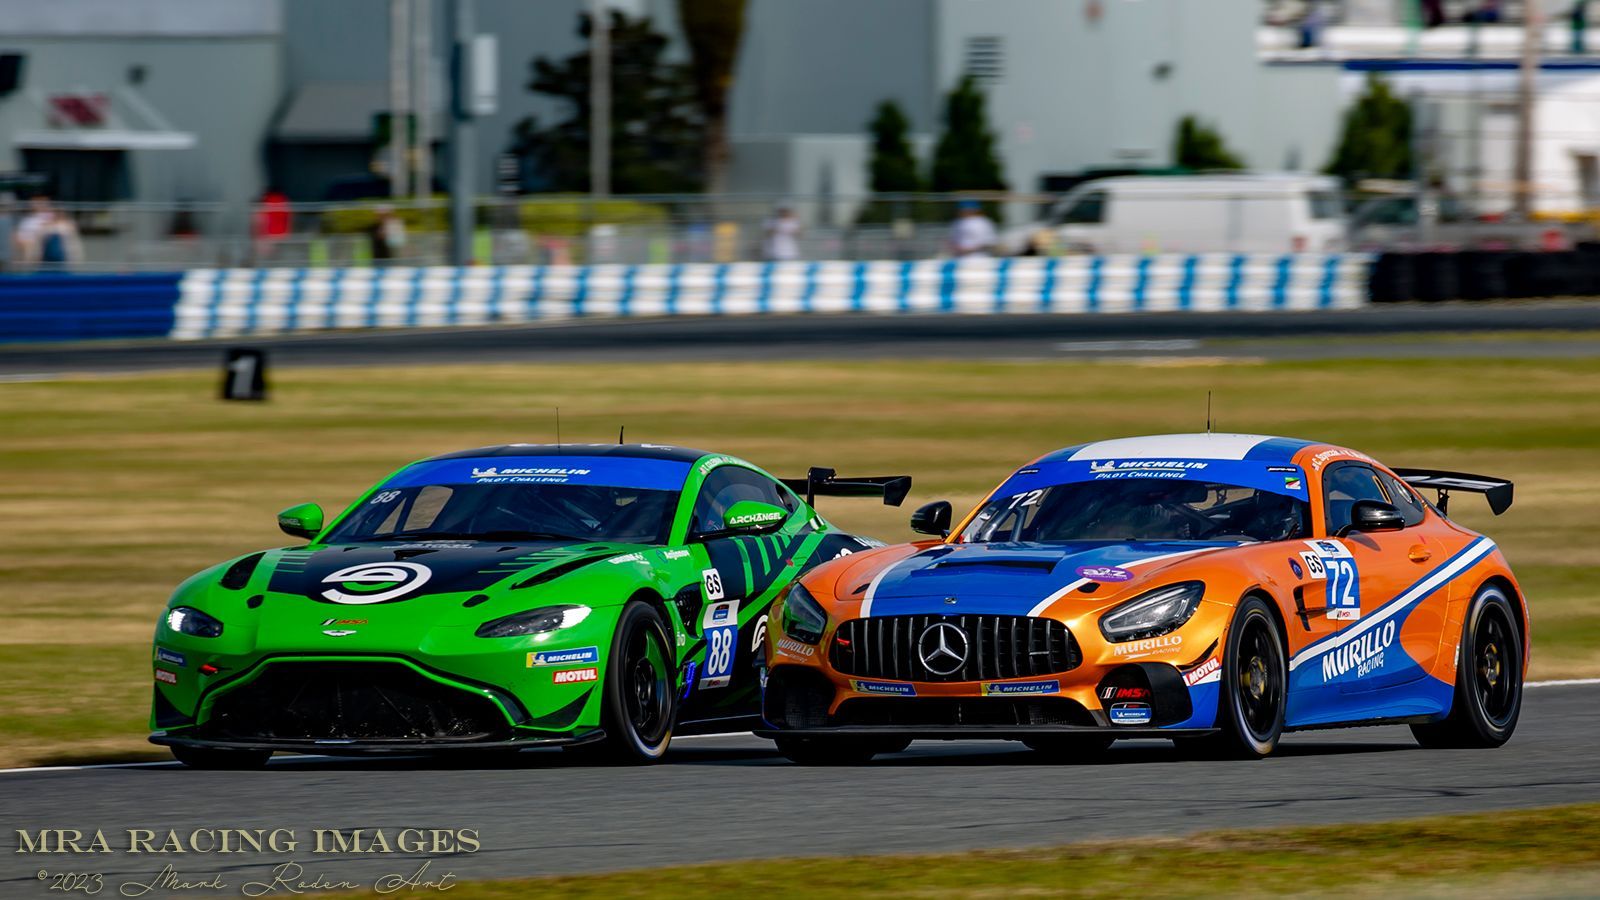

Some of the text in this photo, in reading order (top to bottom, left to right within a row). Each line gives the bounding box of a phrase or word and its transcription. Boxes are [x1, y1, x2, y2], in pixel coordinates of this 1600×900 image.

[1118, 461, 1208, 469] MICHELIN
[1095, 471, 1187, 479] PILOT CHALLENGE
[370, 490, 402, 504] 88
[1008, 489, 1043, 510] 72
[729, 512, 782, 525] ARCHANGEL
[1304, 555, 1324, 574] GS
[706, 573, 721, 595] GS
[1325, 560, 1355, 606] 72
[707, 628, 732, 676] 88
[777, 638, 815, 657] MURILLO
[1113, 636, 1182, 656] MURILLO
[1322, 619, 1396, 683] MURILLO
[547, 652, 593, 662] MICHELIN
[1357, 651, 1385, 679] RACING
[554, 669, 597, 683] MOTUL
[1188, 657, 1220, 685] MOTUL
[1003, 684, 1053, 692] MICHELIN
